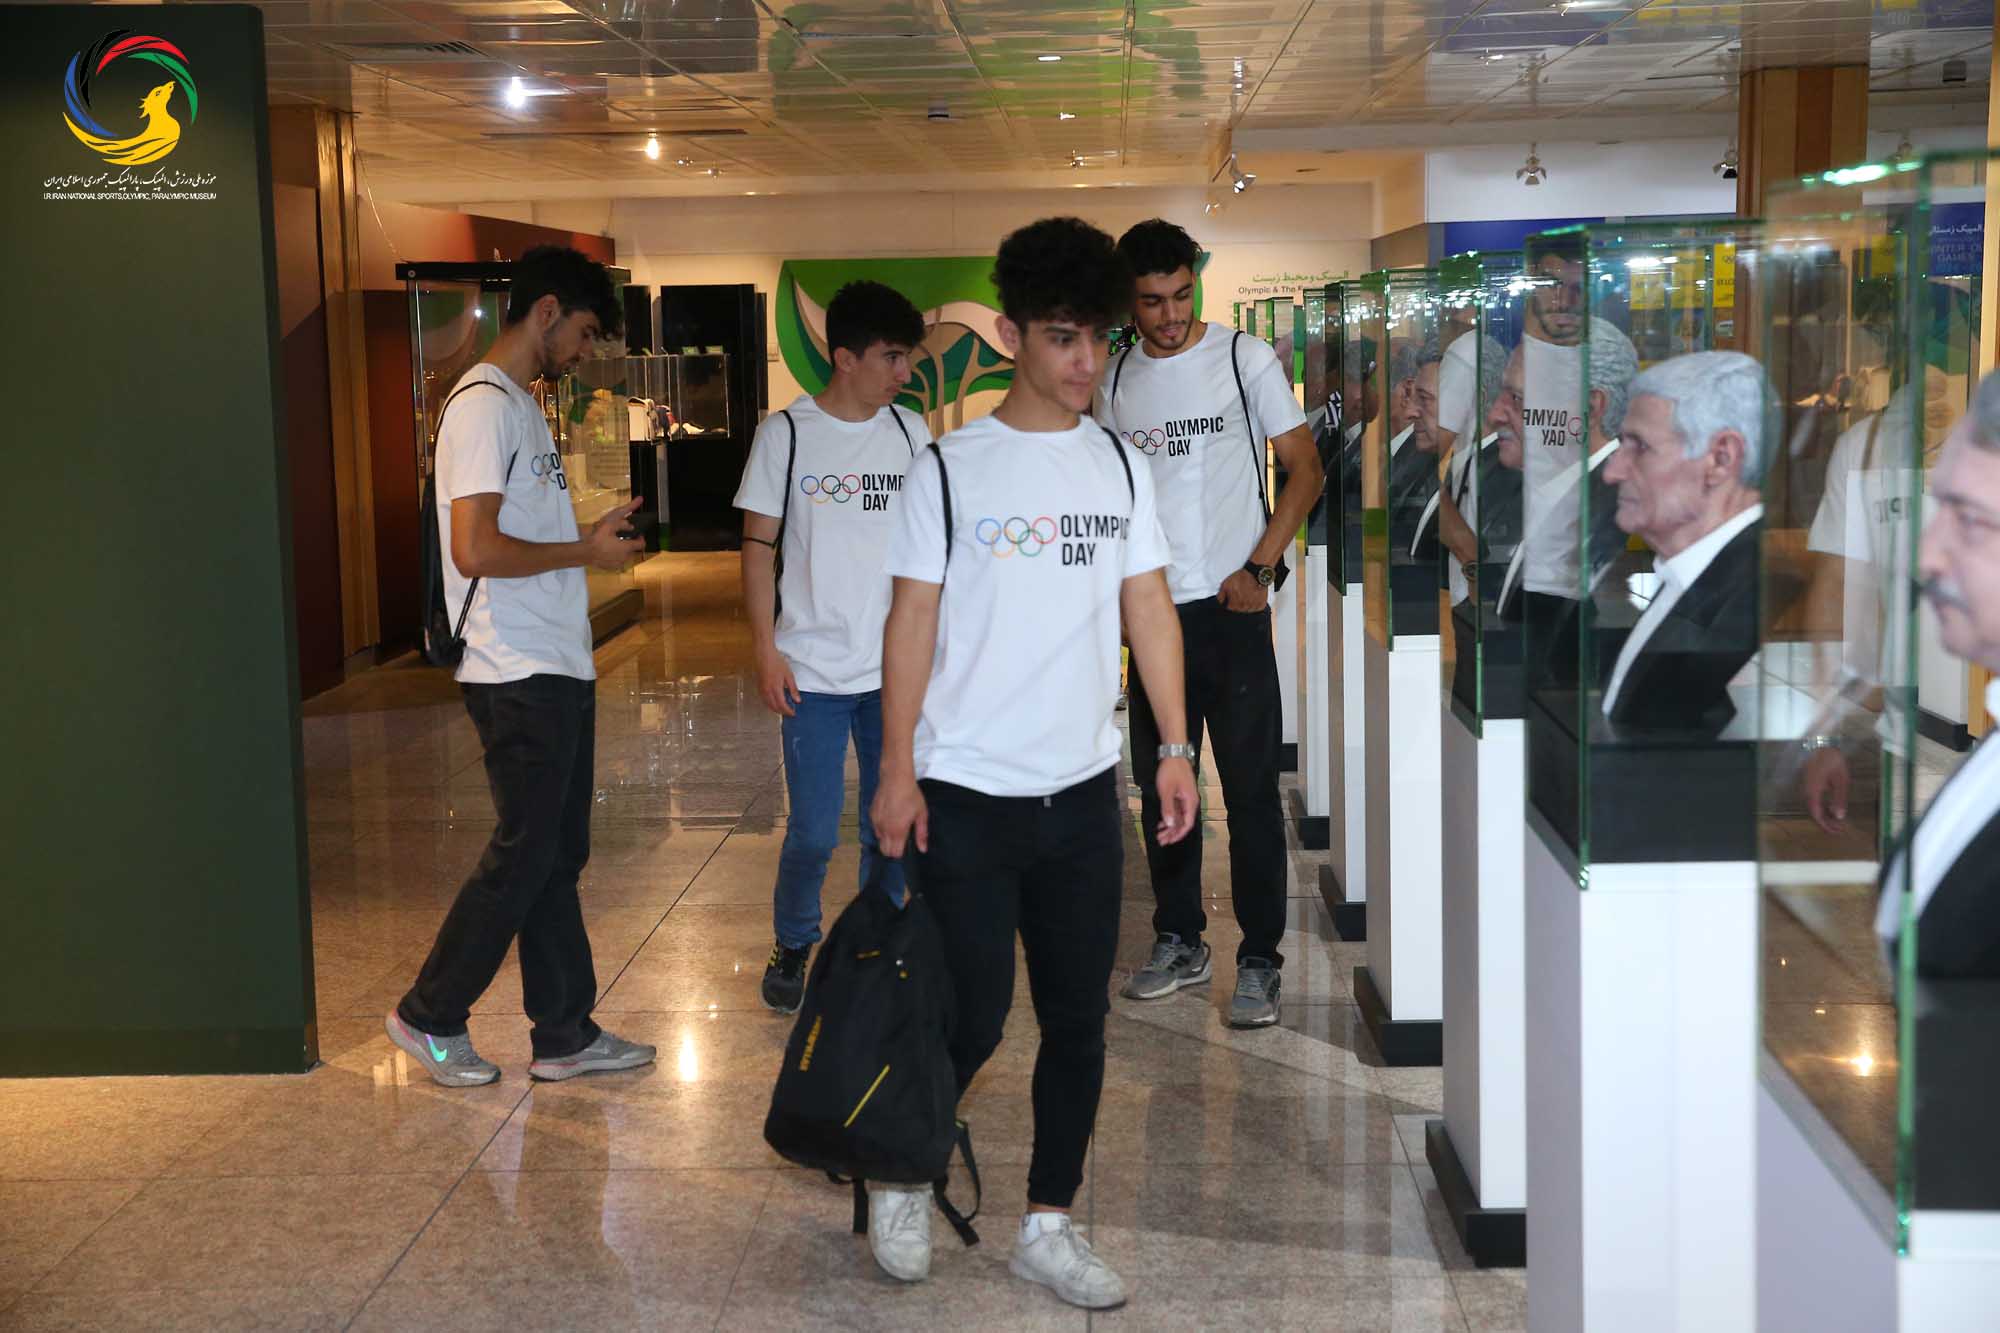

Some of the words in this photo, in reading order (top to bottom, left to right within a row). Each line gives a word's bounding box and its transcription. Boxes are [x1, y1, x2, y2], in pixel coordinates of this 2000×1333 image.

[1238, 286, 1270, 296] Olympic
[1272, 286, 1279, 294] &
[1281, 286, 1296, 294] The
[1165, 416, 1224, 438] OLYMPIC
[1168, 439, 1191, 457] DAY
[863, 493, 889, 511] DAY
[1062, 543, 1096, 566] DAY
